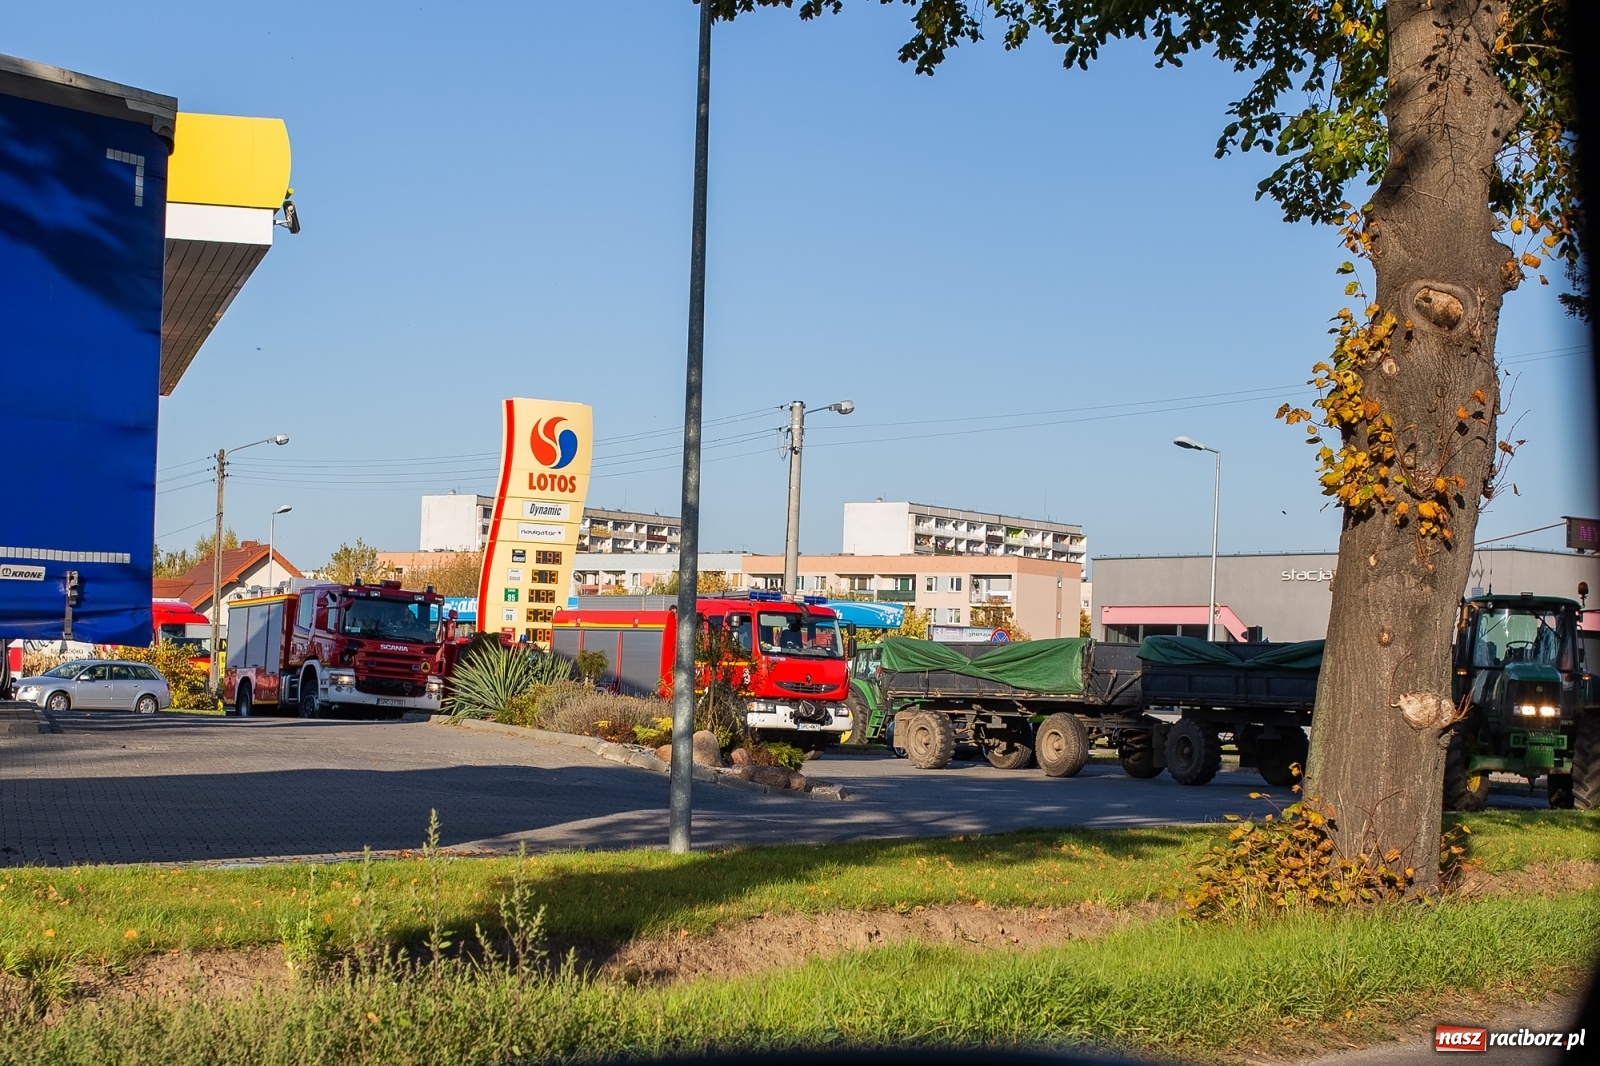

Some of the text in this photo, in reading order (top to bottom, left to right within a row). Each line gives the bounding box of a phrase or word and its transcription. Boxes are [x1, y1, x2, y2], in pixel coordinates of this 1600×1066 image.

[528, 472, 576, 493] LOTOS
[529, 503, 562, 516] Dynamic
[12, 570, 43, 579] KRONE
[1281, 567, 1333, 582] stacja
[380, 644, 408, 652] SCANIA
